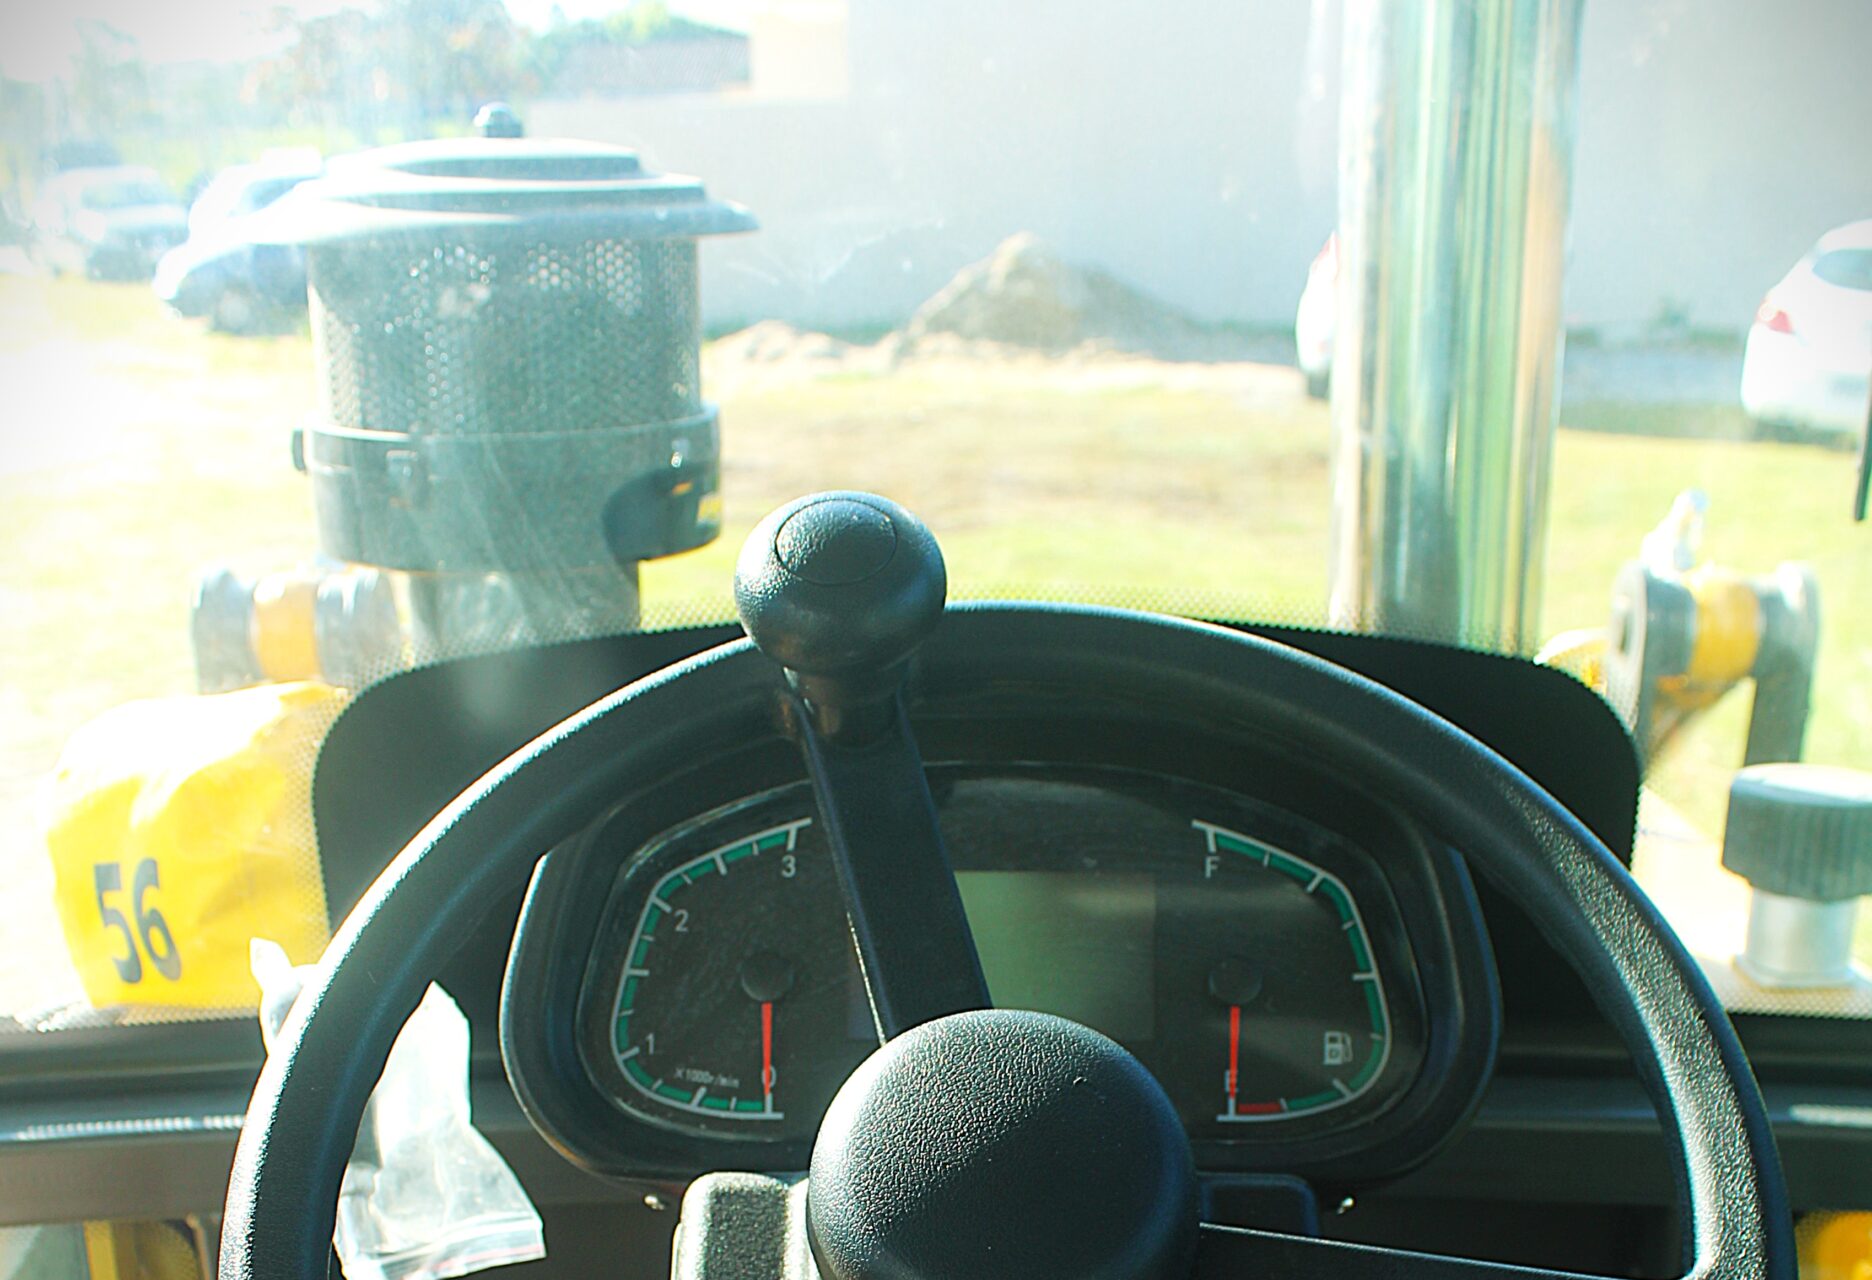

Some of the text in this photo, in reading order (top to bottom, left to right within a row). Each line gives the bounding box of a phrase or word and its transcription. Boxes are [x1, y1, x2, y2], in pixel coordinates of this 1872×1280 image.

[780, 855, 797, 878] 3
[1206, 856, 1221, 878] F
[94, 857, 182, 984] 56
[675, 911, 689, 932] 2
[645, 1034, 655, 1054] 1
